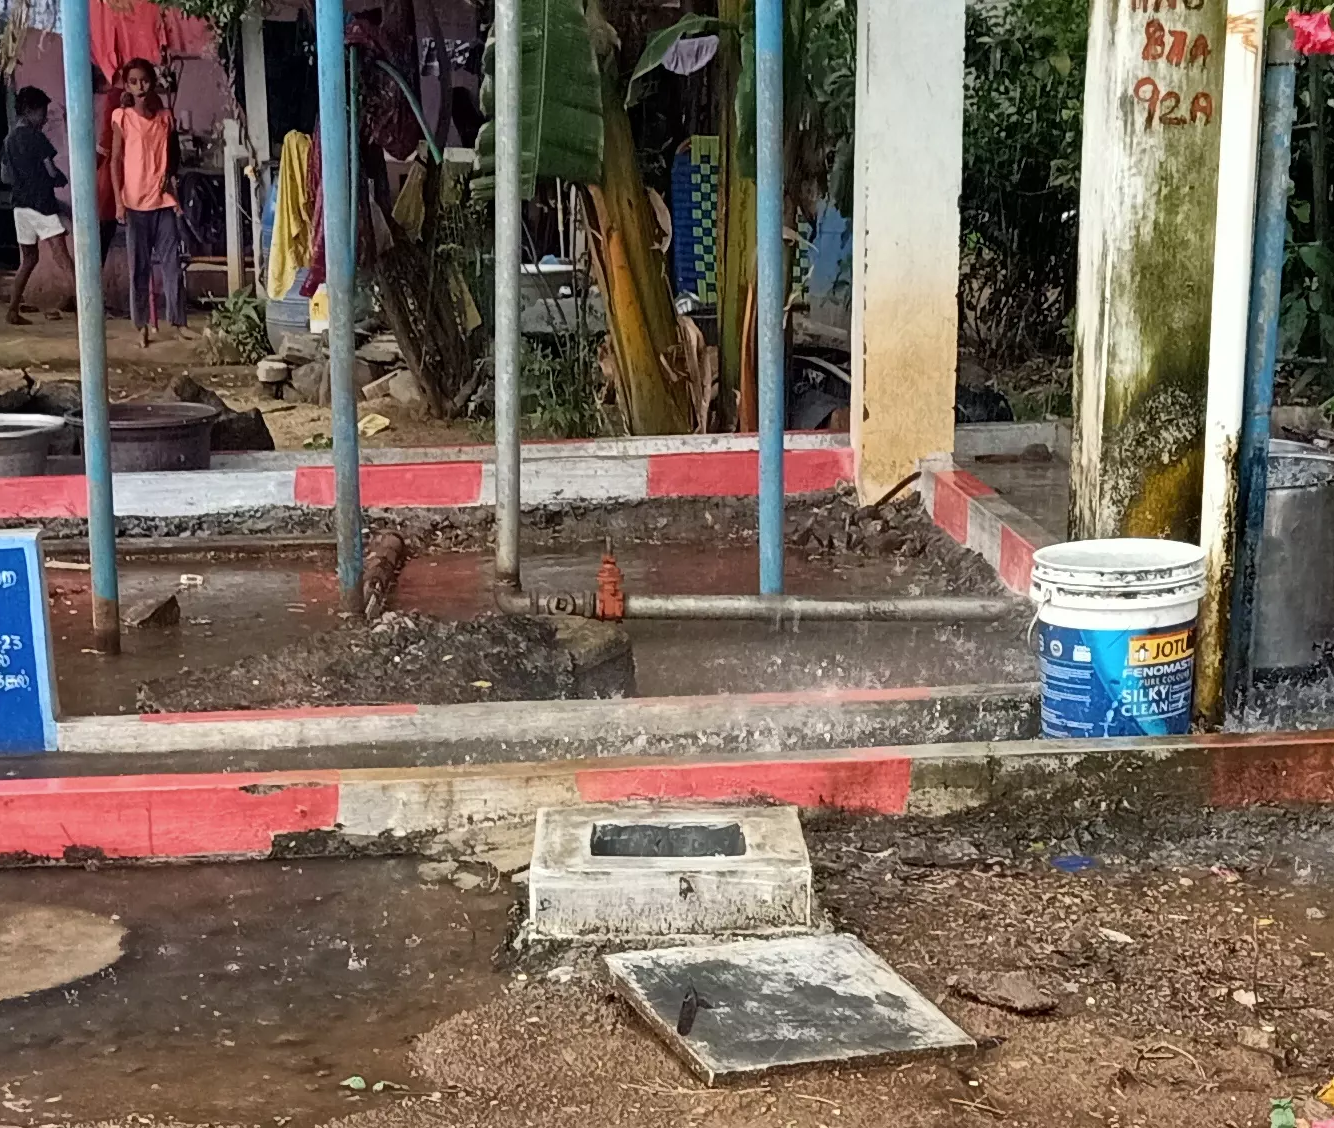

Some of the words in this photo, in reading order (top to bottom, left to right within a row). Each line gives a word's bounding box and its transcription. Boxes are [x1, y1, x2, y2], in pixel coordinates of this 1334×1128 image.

[1152, 638, 1189, 660] JOTU
[1121, 685, 1169, 703] SILKY
[1121, 700, 1169, 716] CLEAN
